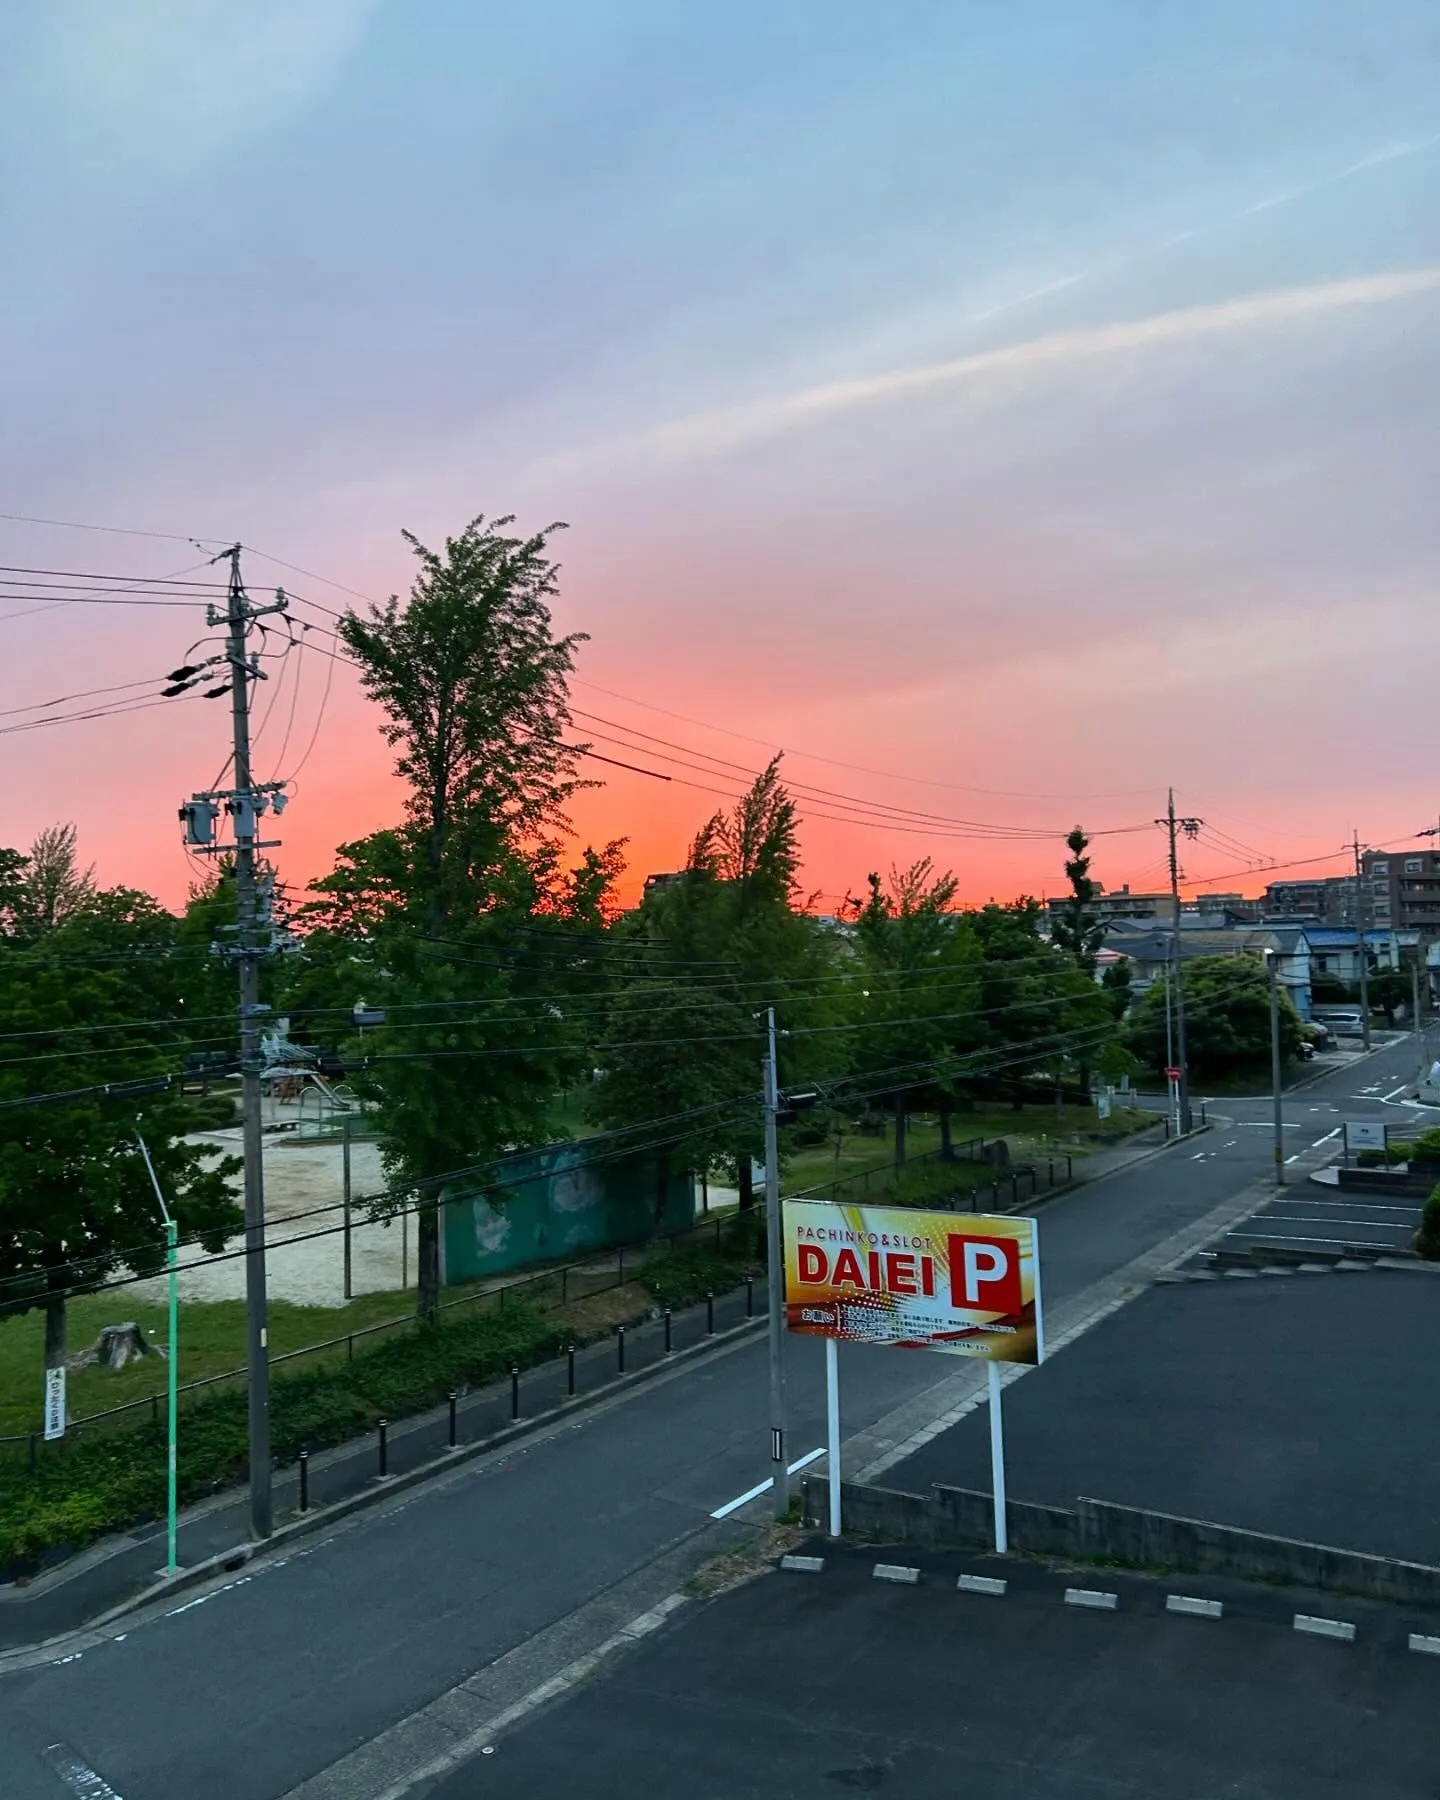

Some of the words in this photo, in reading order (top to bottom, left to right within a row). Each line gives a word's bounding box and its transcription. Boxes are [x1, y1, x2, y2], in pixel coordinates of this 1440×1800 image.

[797, 1226, 932, 1249] PACHINKO&SLOT
[797, 1243, 936, 1297] DAIEI
[963, 1242, 1008, 1303] P
